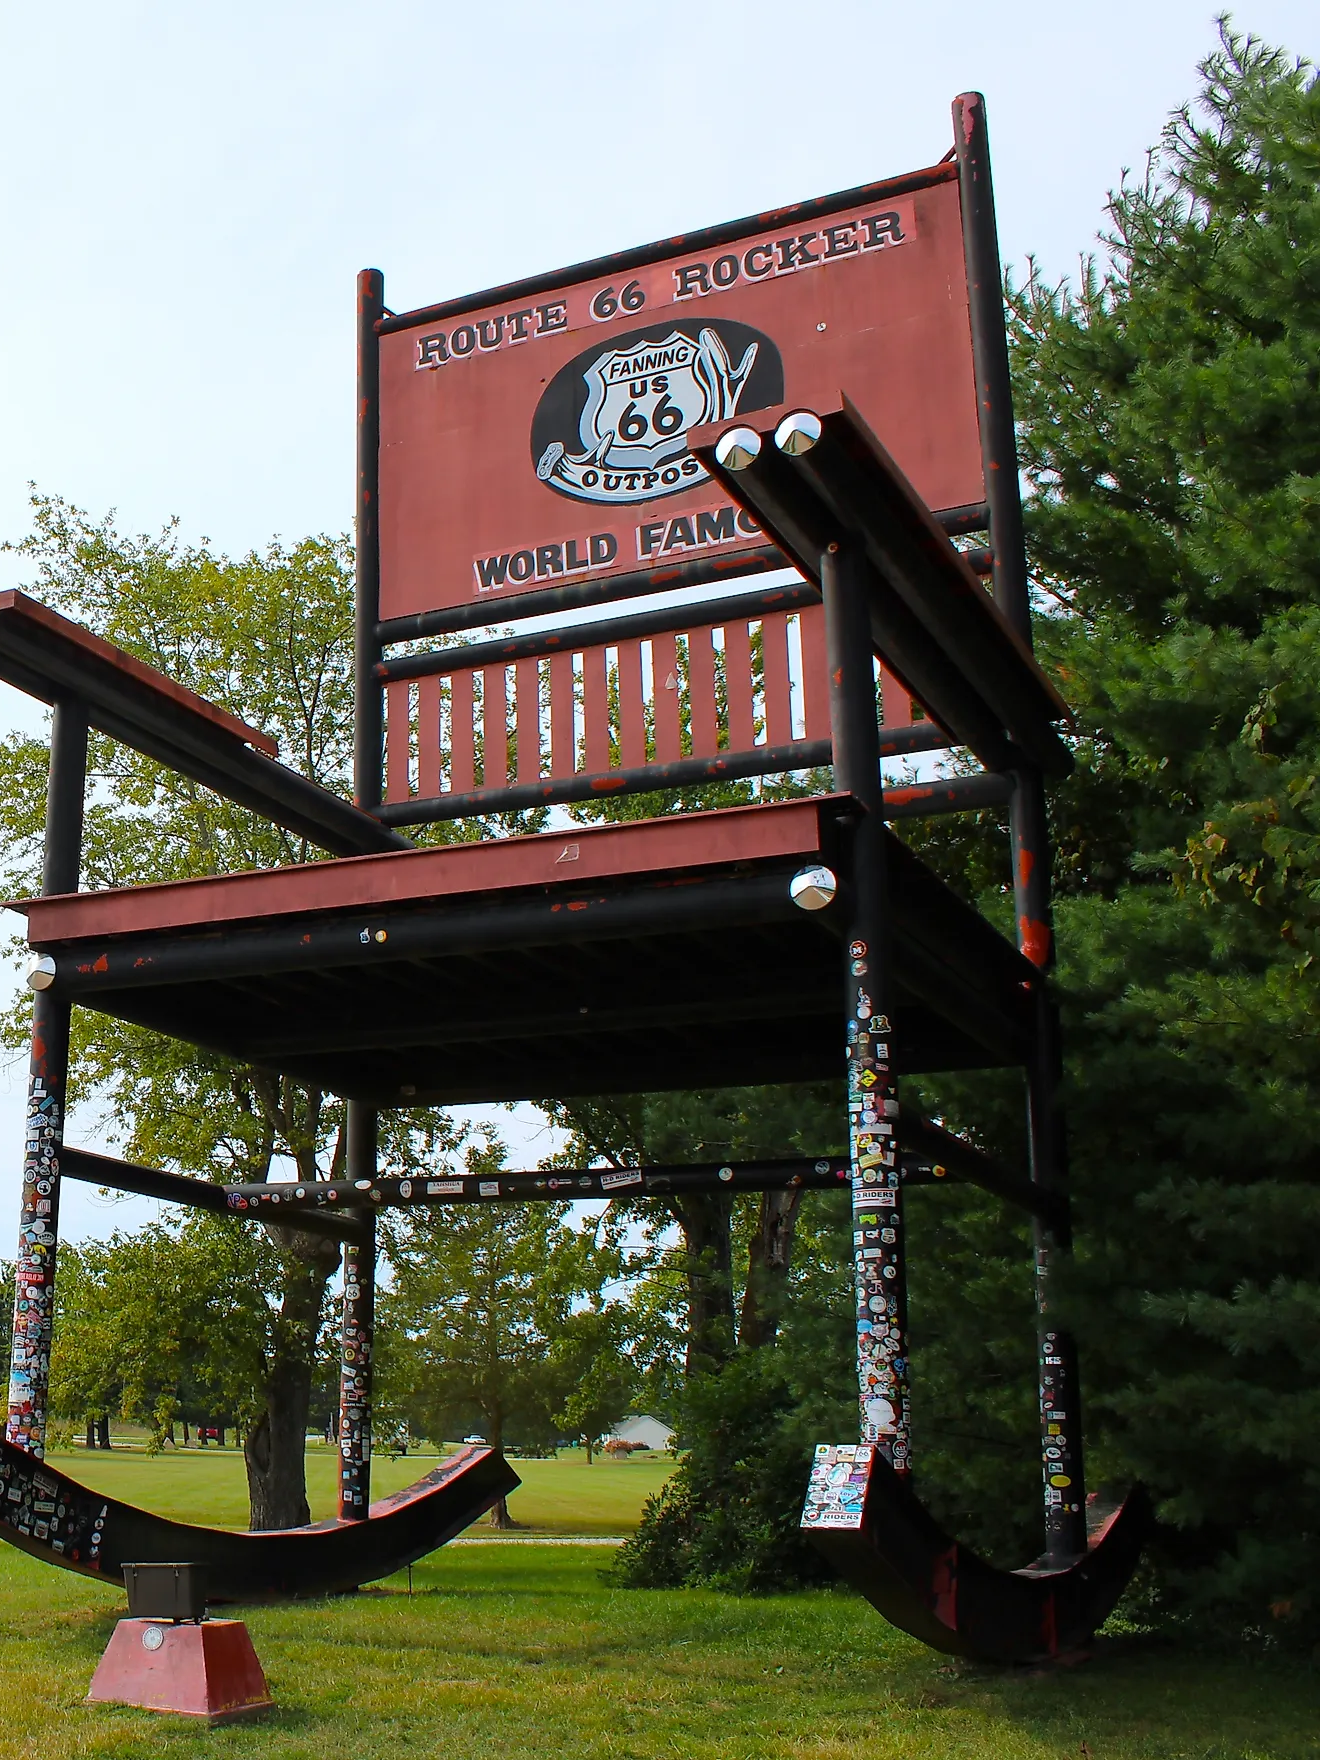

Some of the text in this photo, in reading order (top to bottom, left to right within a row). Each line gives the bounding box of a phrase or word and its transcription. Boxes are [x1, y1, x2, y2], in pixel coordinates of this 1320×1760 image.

[415, 211, 906, 371] ROUTE 66 ROCKER
[609, 346, 690, 380] FANNING
[629, 376, 669, 399] US
[617, 393, 684, 442] 66
[581, 458, 700, 491] OUTPOS
[473, 506, 763, 592] WORLD FAMO
